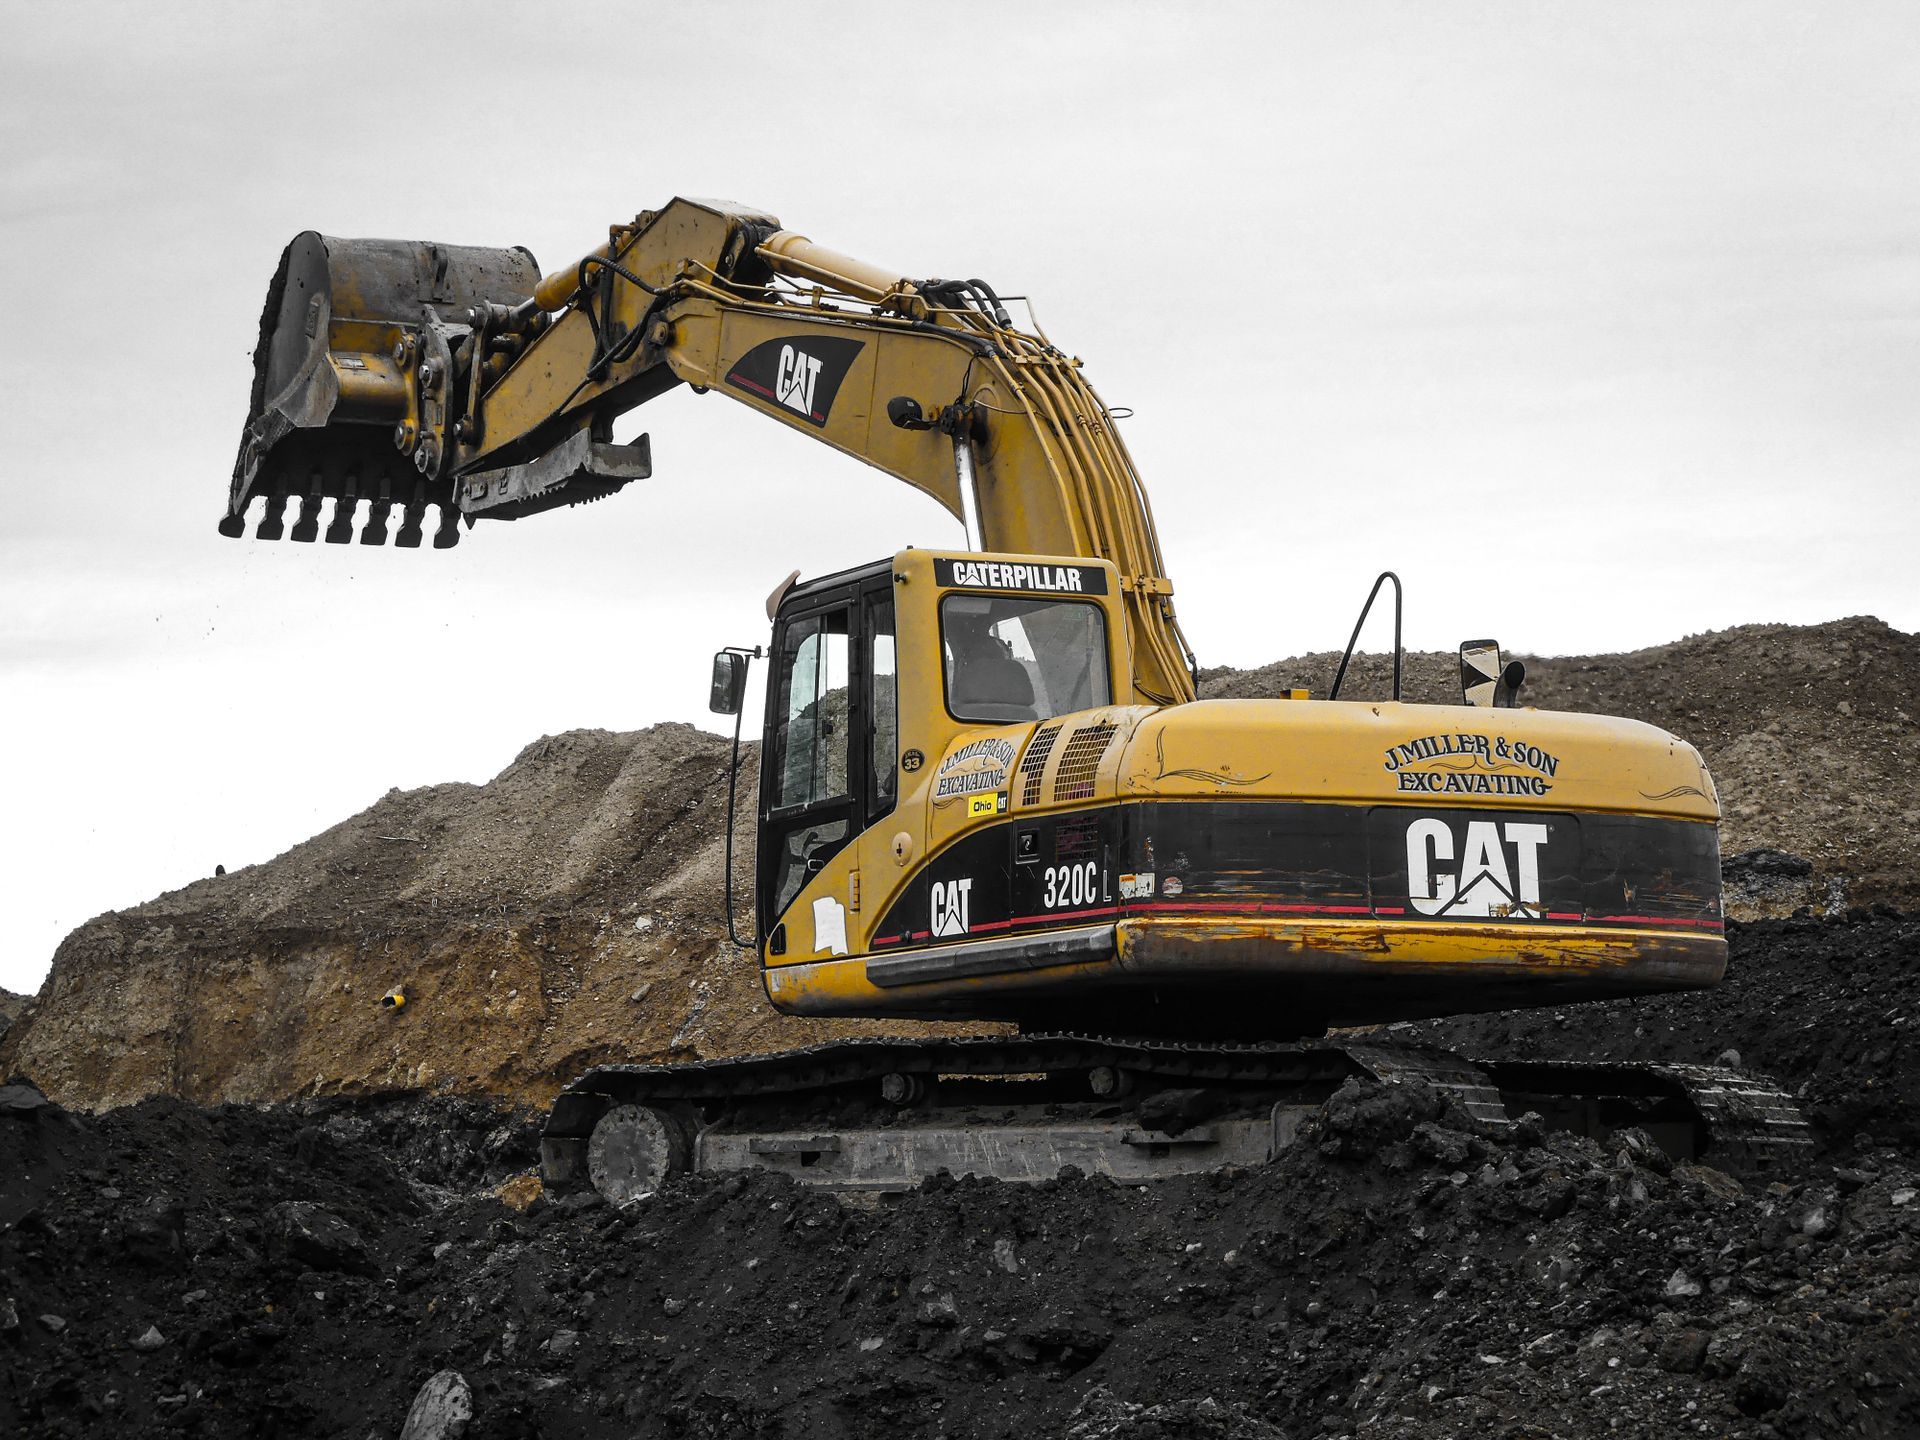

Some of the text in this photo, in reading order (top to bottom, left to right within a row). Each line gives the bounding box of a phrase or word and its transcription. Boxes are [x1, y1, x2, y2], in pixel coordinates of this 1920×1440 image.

[775, 344, 823, 416] CAT
[952, 561, 1082, 592] CATERPILLAR
[904, 757, 920, 770] 33
[1495, 736, 1512, 759] &
[1512, 741, 1560, 777] SON
[936, 768, 1007, 797] EXCAVATING
[1397, 772, 1553, 796] EXCAVATING
[973, 800, 992, 812] Ohio
[1044, 861, 1112, 908] 320C L
[1406, 818, 1548, 919] CAT
[931, 877, 972, 937] CAT
